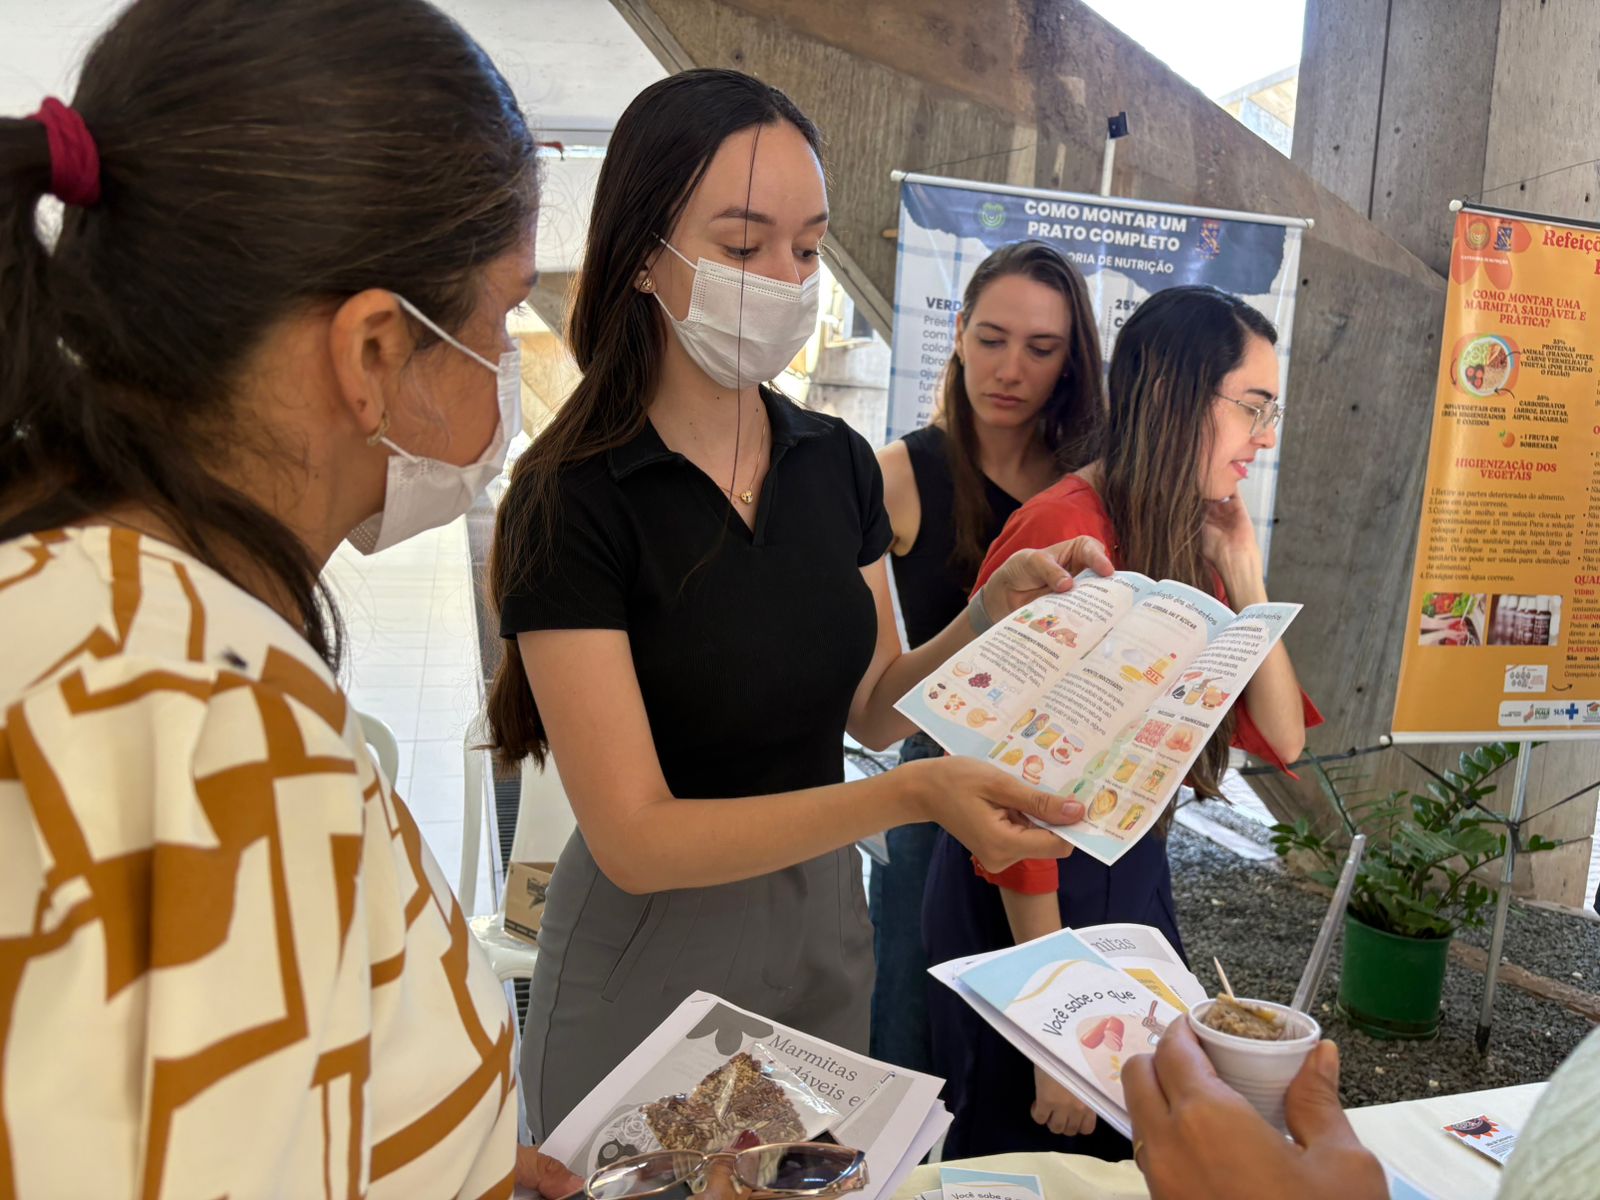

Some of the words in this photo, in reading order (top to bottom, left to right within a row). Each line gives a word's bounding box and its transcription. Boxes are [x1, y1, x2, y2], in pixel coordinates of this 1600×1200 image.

[1024, 200, 1080, 219] COMO
[1082, 206, 1158, 229] MONTAR
[1160, 217, 1187, 232] UM
[1027, 221, 1087, 241] PRATO
[1089, 226, 1180, 252] COMPLETO
[1542, 229, 1600, 255] Refeiçõ
[1098, 255, 1112, 266] DE
[1114, 257, 1174, 274] NUTRIÇÃO
[926, 296, 962, 311] VERD
[1473, 290, 1506, 301] COMO
[1508, 292, 1553, 307] MONTAR
[1556, 298, 1580, 310] UMA
[1464, 300, 1518, 314] MARMITA
[1520, 304, 1576, 320] SAUDÁVEL
[1580, 311, 1586, 321] E
[1499, 312, 1550, 328] PRÁTICA?
[1522, 348, 1546, 356] ANIMAL
[921, 354, 945, 367] fibro
[1520, 362, 1546, 370] VEGETAL
[1564, 365, 1593, 374] EXEMPLO
[1489, 406, 1506, 414] CRUS
[1519, 400, 1566, 410] CARBOIDRATOS
[1528, 434, 1550, 442] FRUTA
[1520, 441, 1558, 450] SOBREMESA
[1456, 458, 1534, 471] HIGIENIZAÇÃO
[1536, 462, 1557, 472] DOS
[1480, 469, 1532, 480] VEGETAIS
[1466, 490, 1487, 498] partes
[1488, 491, 1527, 499] deterioradas
[1463, 499, 1478, 507] água
[1432, 518, 1491, 526] aproximadamente
[1552, 522, 1574, 530] solução
[1463, 537, 1479, 545] água
[1502, 548, 1538, 556] embalagem
[1534, 558, 1570, 566] desinfecção
[1470, 574, 1486, 582] água
[1574, 588, 1594, 596] VIDRO
[1185, 602, 1218, 626] alimentos
[1179, 616, 1198, 630] AÇÚCAR
[1570, 622, 1588, 630] Podem
[1567, 646, 1598, 654] PLÁSTICO
[1145, 669, 1160, 682] OIL
[1554, 708, 1564, 716] SUS
[1090, 937, 1137, 953] mitas
[1042, 1008, 1068, 1038] Você
[1064, 992, 1093, 1014] sabe
[1096, 991, 1104, 1000] o
[1107, 989, 1136, 1004] que
[768, 1035, 858, 1082] Marmitas
[788, 1064, 846, 1098] dáveis
[848, 1094, 861, 1108] e
[952, 1192, 974, 1200] Você
[978, 1192, 1002, 1200] sabe
